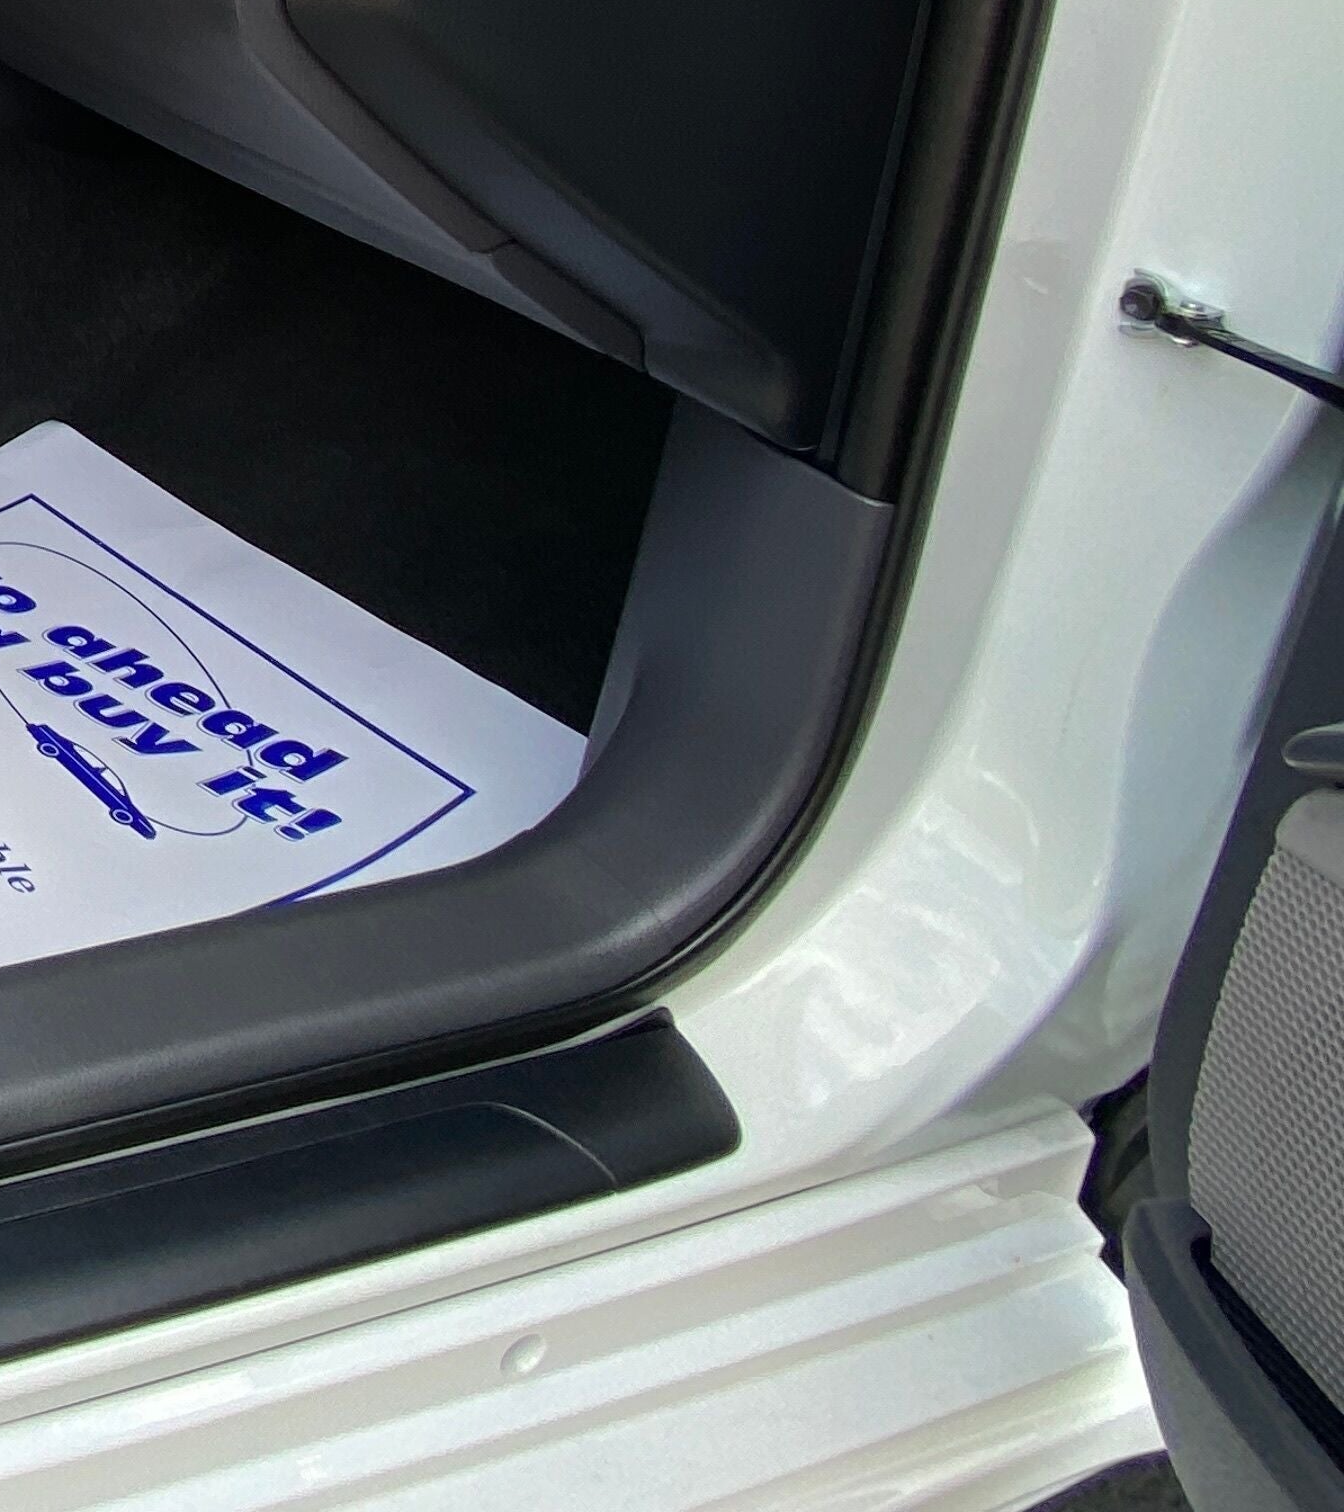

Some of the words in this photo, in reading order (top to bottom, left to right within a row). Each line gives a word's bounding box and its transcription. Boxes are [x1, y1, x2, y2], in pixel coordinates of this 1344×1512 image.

[17, 659, 203, 758] buy
[196, 764, 344, 842] it!
[42, 624, 350, 783] ahead
